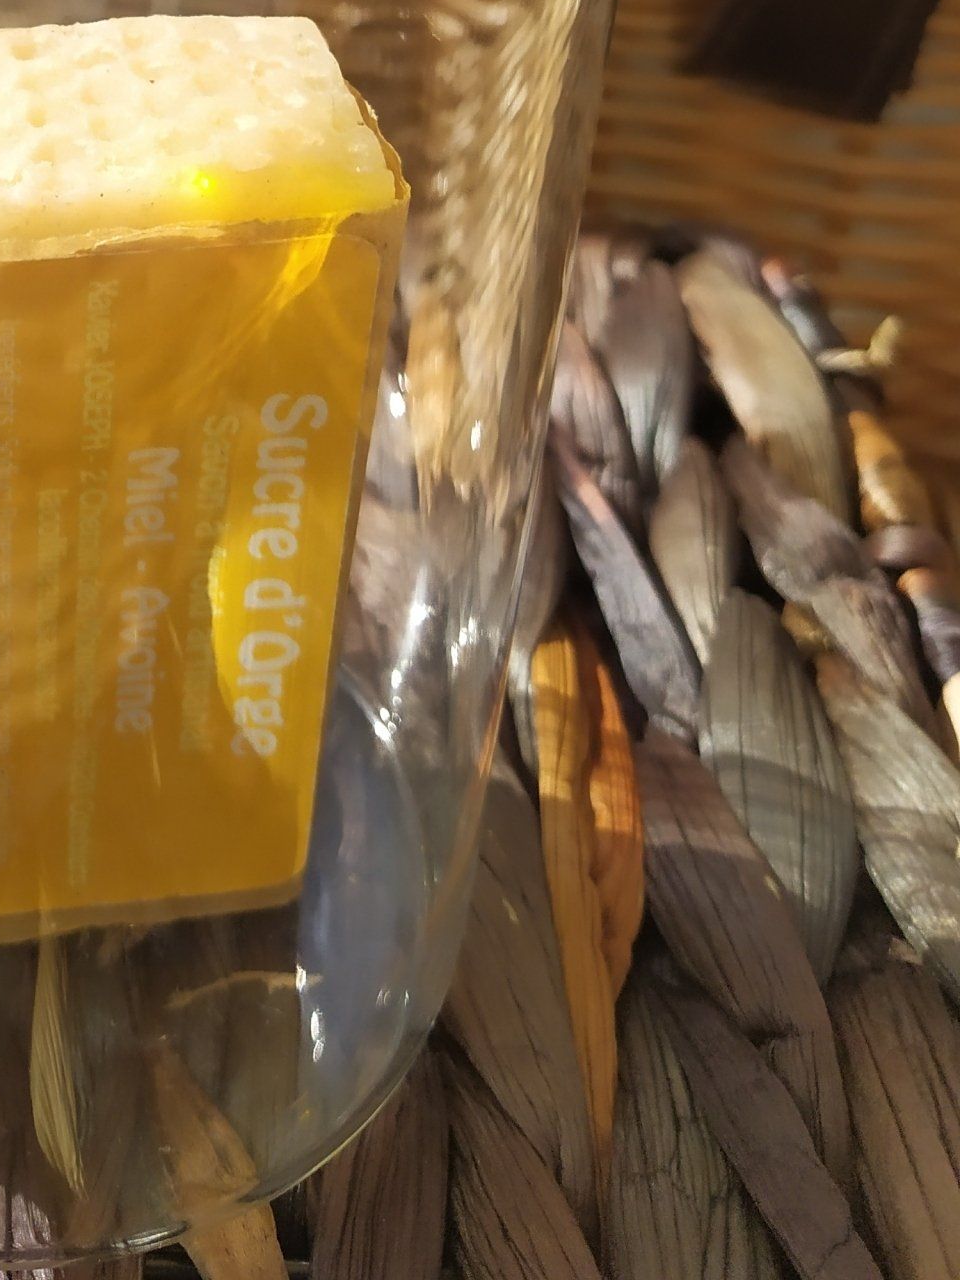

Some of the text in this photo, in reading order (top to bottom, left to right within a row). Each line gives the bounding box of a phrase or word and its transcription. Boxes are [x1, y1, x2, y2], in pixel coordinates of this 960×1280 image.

[80, 359, 114, 451] JOSEPH
[79, 470, 107, 482] 2
[122, 446, 181, 548] Miel
[194, 414, 240, 510] Savon
[230, 393, 328, 758] Sucre d'Orge
[114, 585, 171, 734] Avoine
